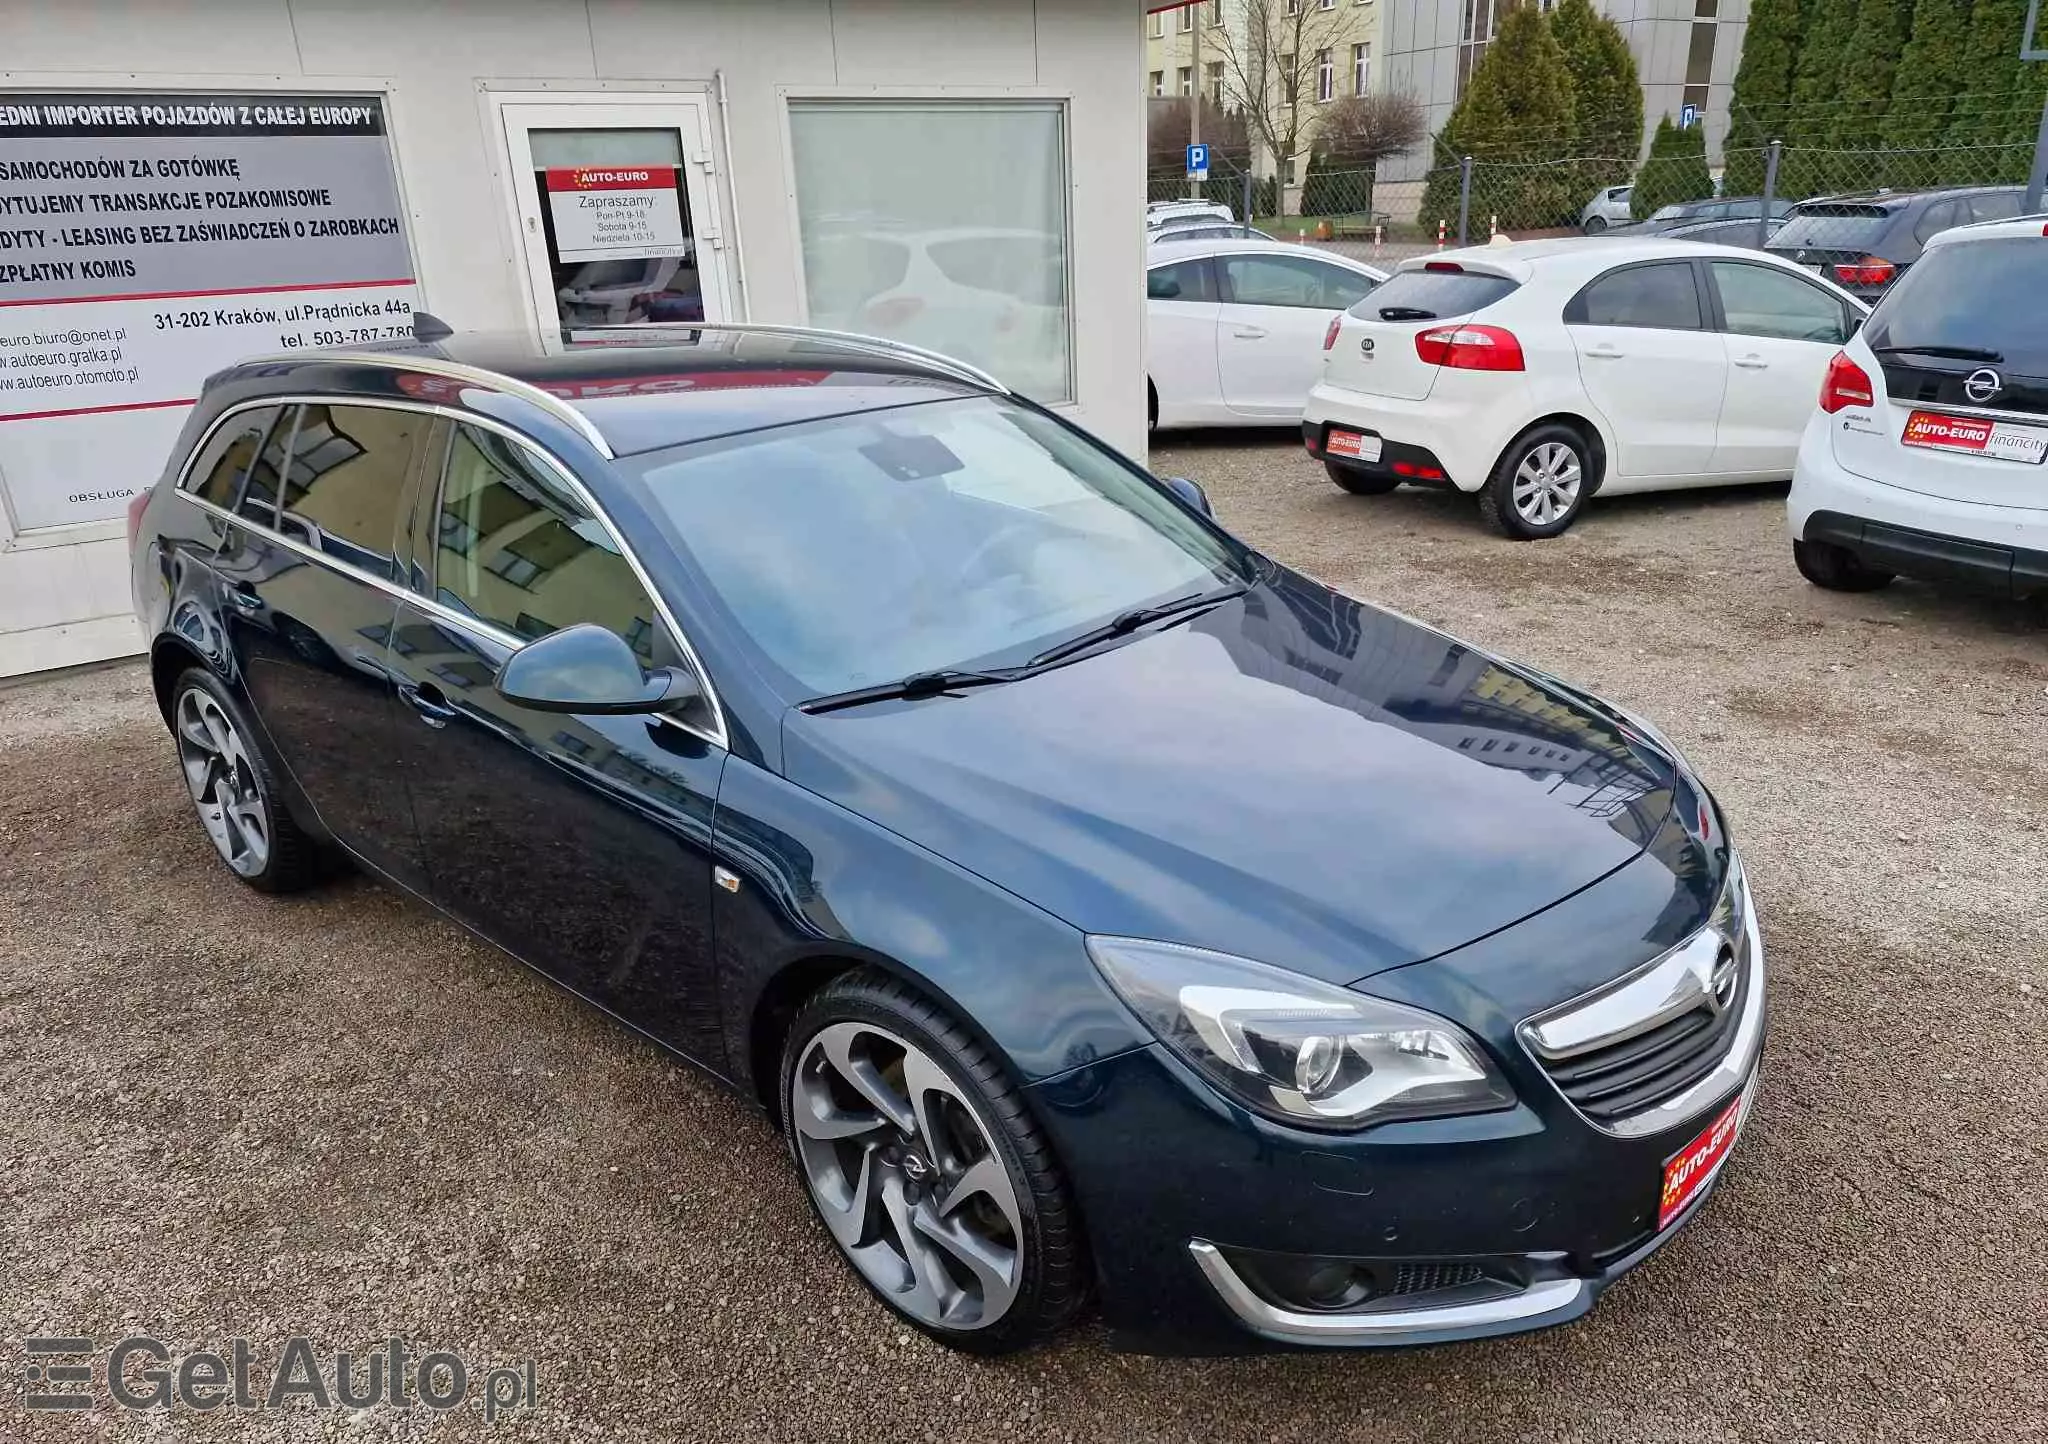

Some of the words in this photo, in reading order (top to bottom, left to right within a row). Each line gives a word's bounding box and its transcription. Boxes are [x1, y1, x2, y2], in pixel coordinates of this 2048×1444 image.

[43, 104, 140, 126] IMPORTER
[141, 102, 236, 126] POJAZDÓW
[239, 105, 253, 126] Z
[254, 104, 306, 126] CAŁEJ
[309, 105, 372, 126] EUROPY
[0, 154, 126, 181] SAMOCHODÓW
[128, 159, 154, 178] ZA
[157, 154, 241, 181] GOTÓWKĘ
[1191, 147, 1204, 167] P
[581, 171, 649, 184] AUTO-EURO
[88, 192, 202, 213] TRANSAKCJE
[205, 189, 332, 210] POZAKOMISOWE
[0, 229, 45, 249] DYTY
[60, 226, 137, 248] LEASING
[141, 224, 172, 245] BEZ
[176, 217, 290, 242] ZAŚWIADCZEŃ
[293, 221, 305, 239] O
[309, 218, 400, 238] ZAROBKACH
[0, 262, 74, 283] ZPŁATNY
[80, 259, 137, 280] KOMIS
[154, 310, 211, 330] 31-202
[214, 304, 281, 325] Kraków,
[285, 302, 381, 322] ul.Prądnicka
[384, 299, 411, 315] 44a
[280, 333, 309, 349] tel.
[1914, 422, 1987, 441] AUTO-EURO
[1668, 1108, 1739, 1194] AUTO-EURO
